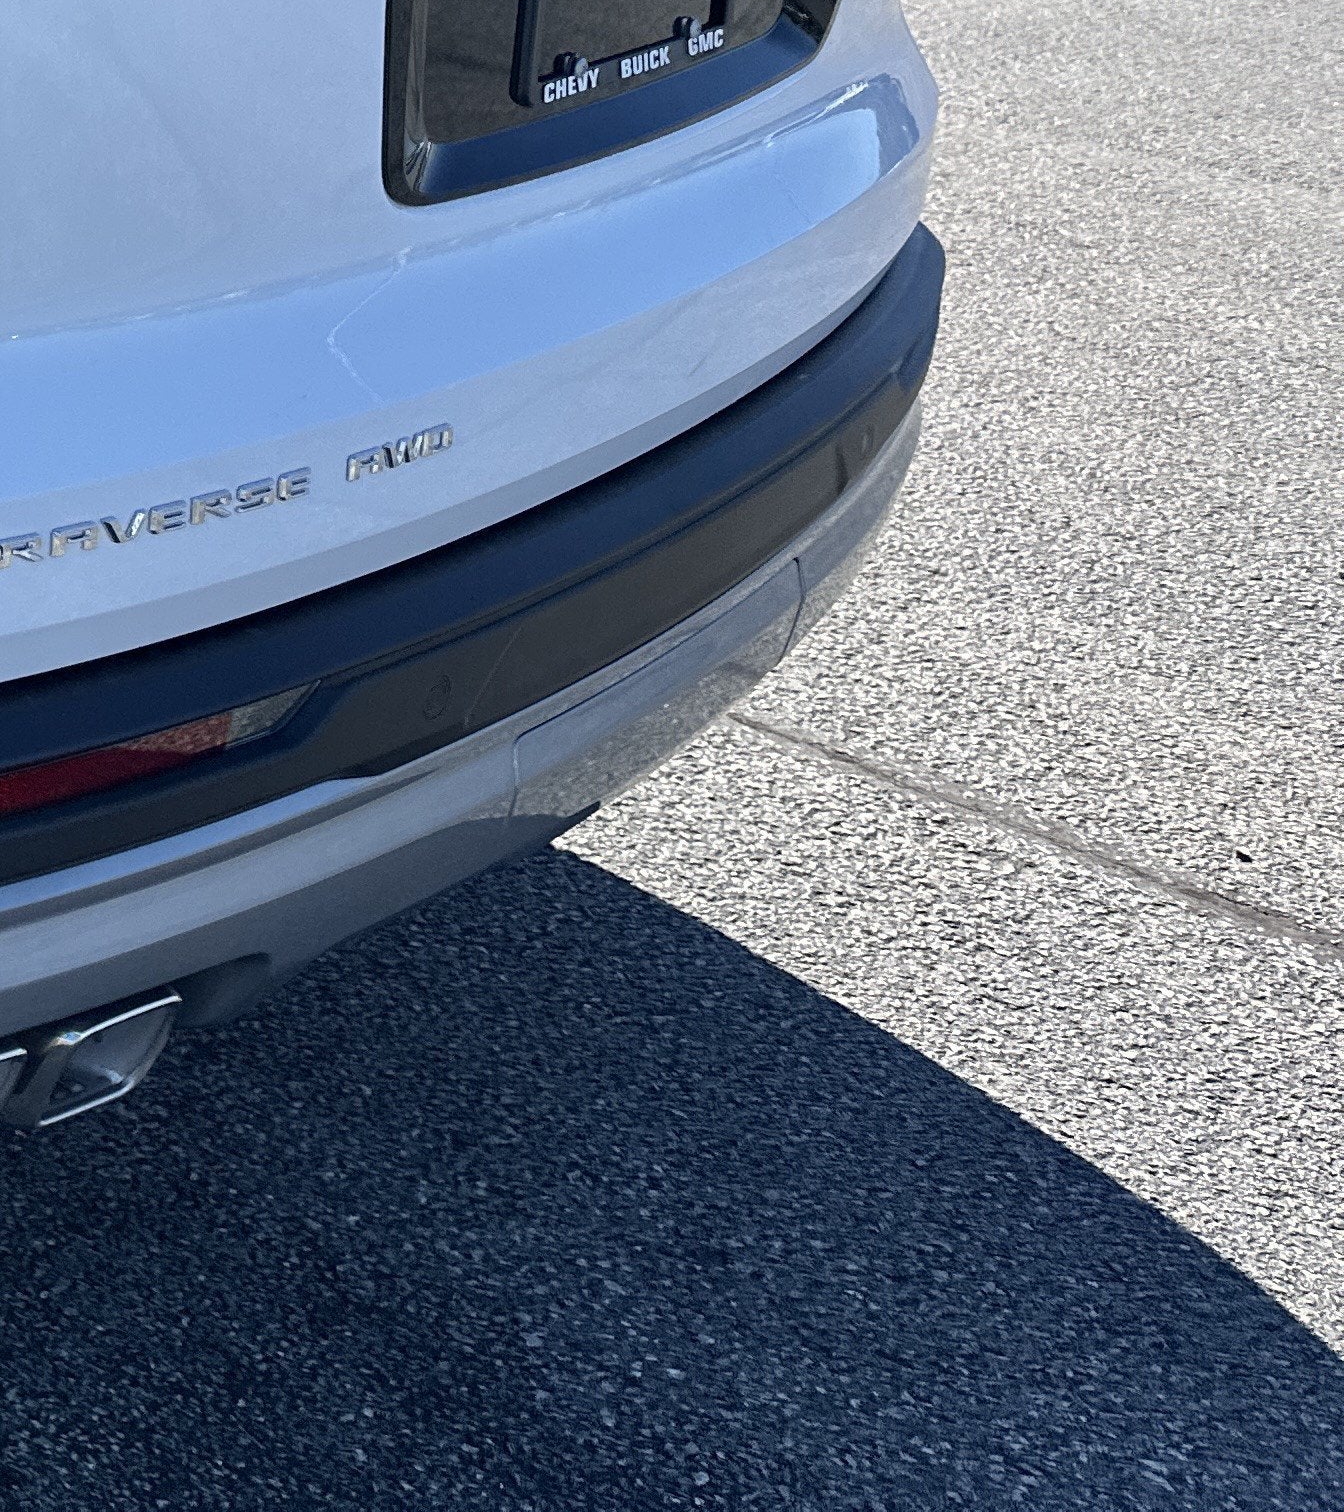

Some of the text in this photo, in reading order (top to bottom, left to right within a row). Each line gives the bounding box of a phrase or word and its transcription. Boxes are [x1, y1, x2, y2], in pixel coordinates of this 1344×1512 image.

[543, 28, 724, 104] CHEVY BUICK GMC
[345, 422, 454, 482] AWD
